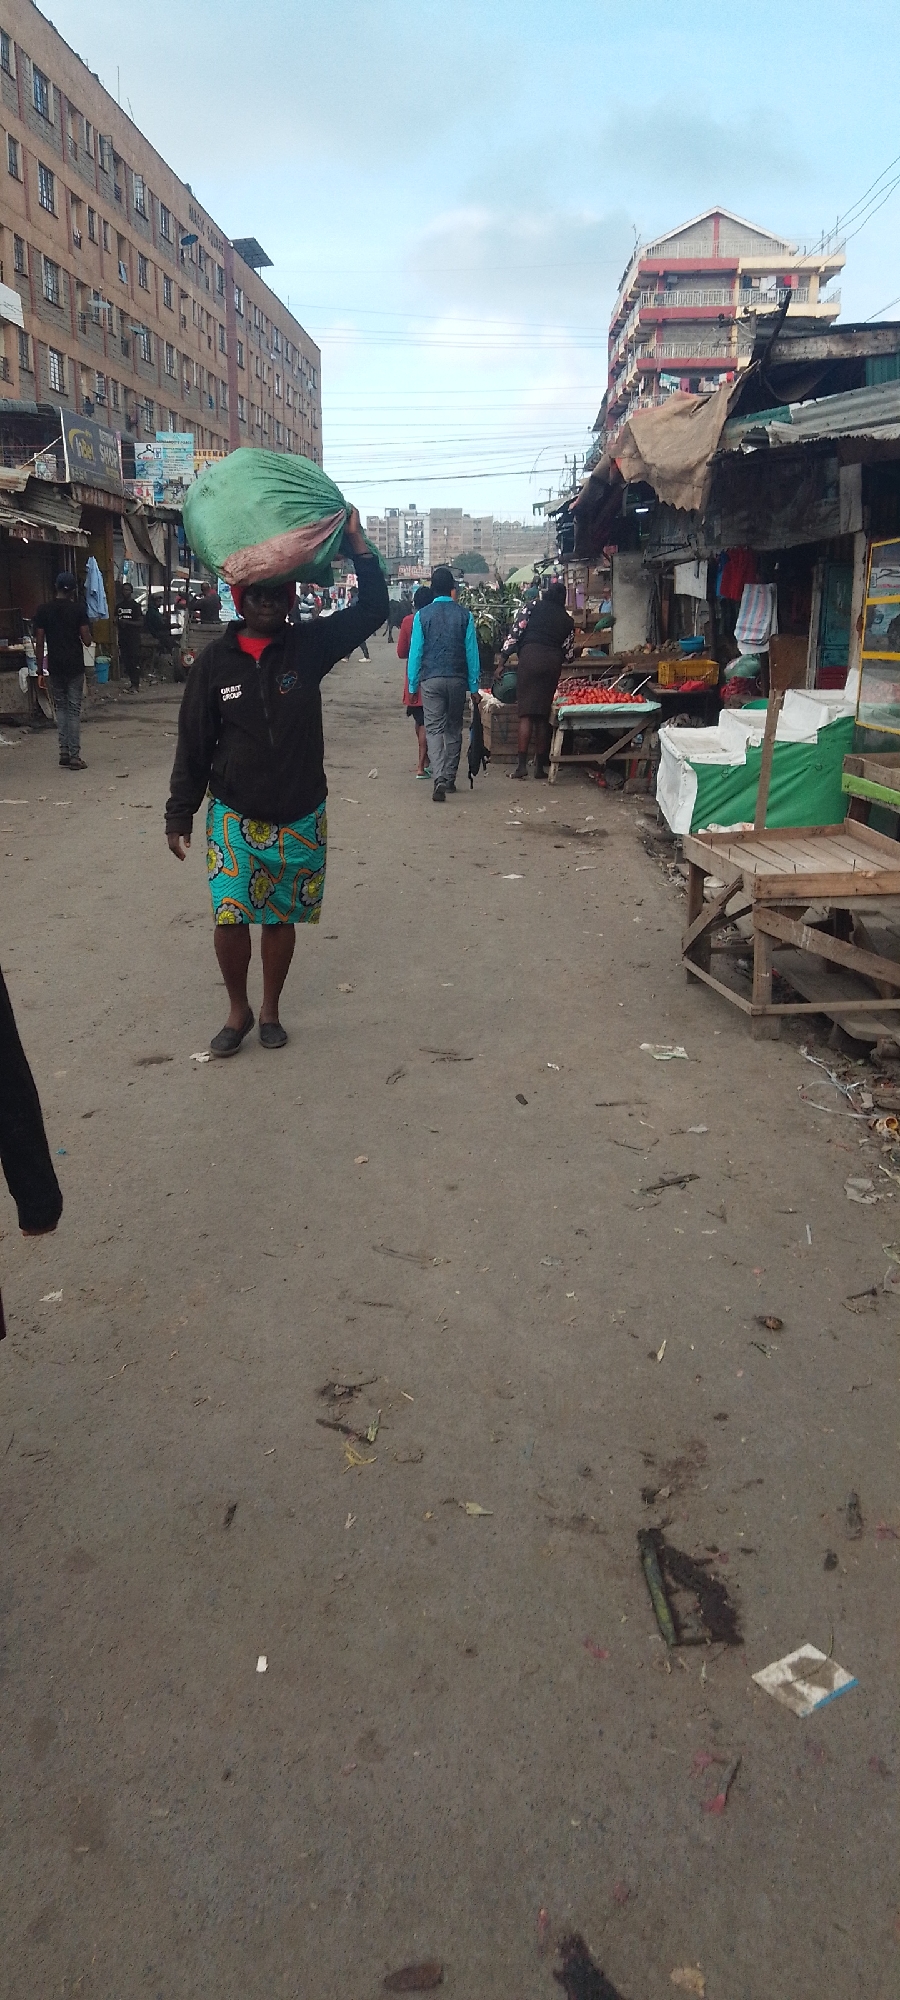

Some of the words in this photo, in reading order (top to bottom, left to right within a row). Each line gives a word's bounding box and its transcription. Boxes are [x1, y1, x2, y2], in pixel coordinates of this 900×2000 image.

[98, 443, 118, 468] SHOP
[220, 684, 242, 694] ORBIT
[222, 691, 242, 701] GROUP
